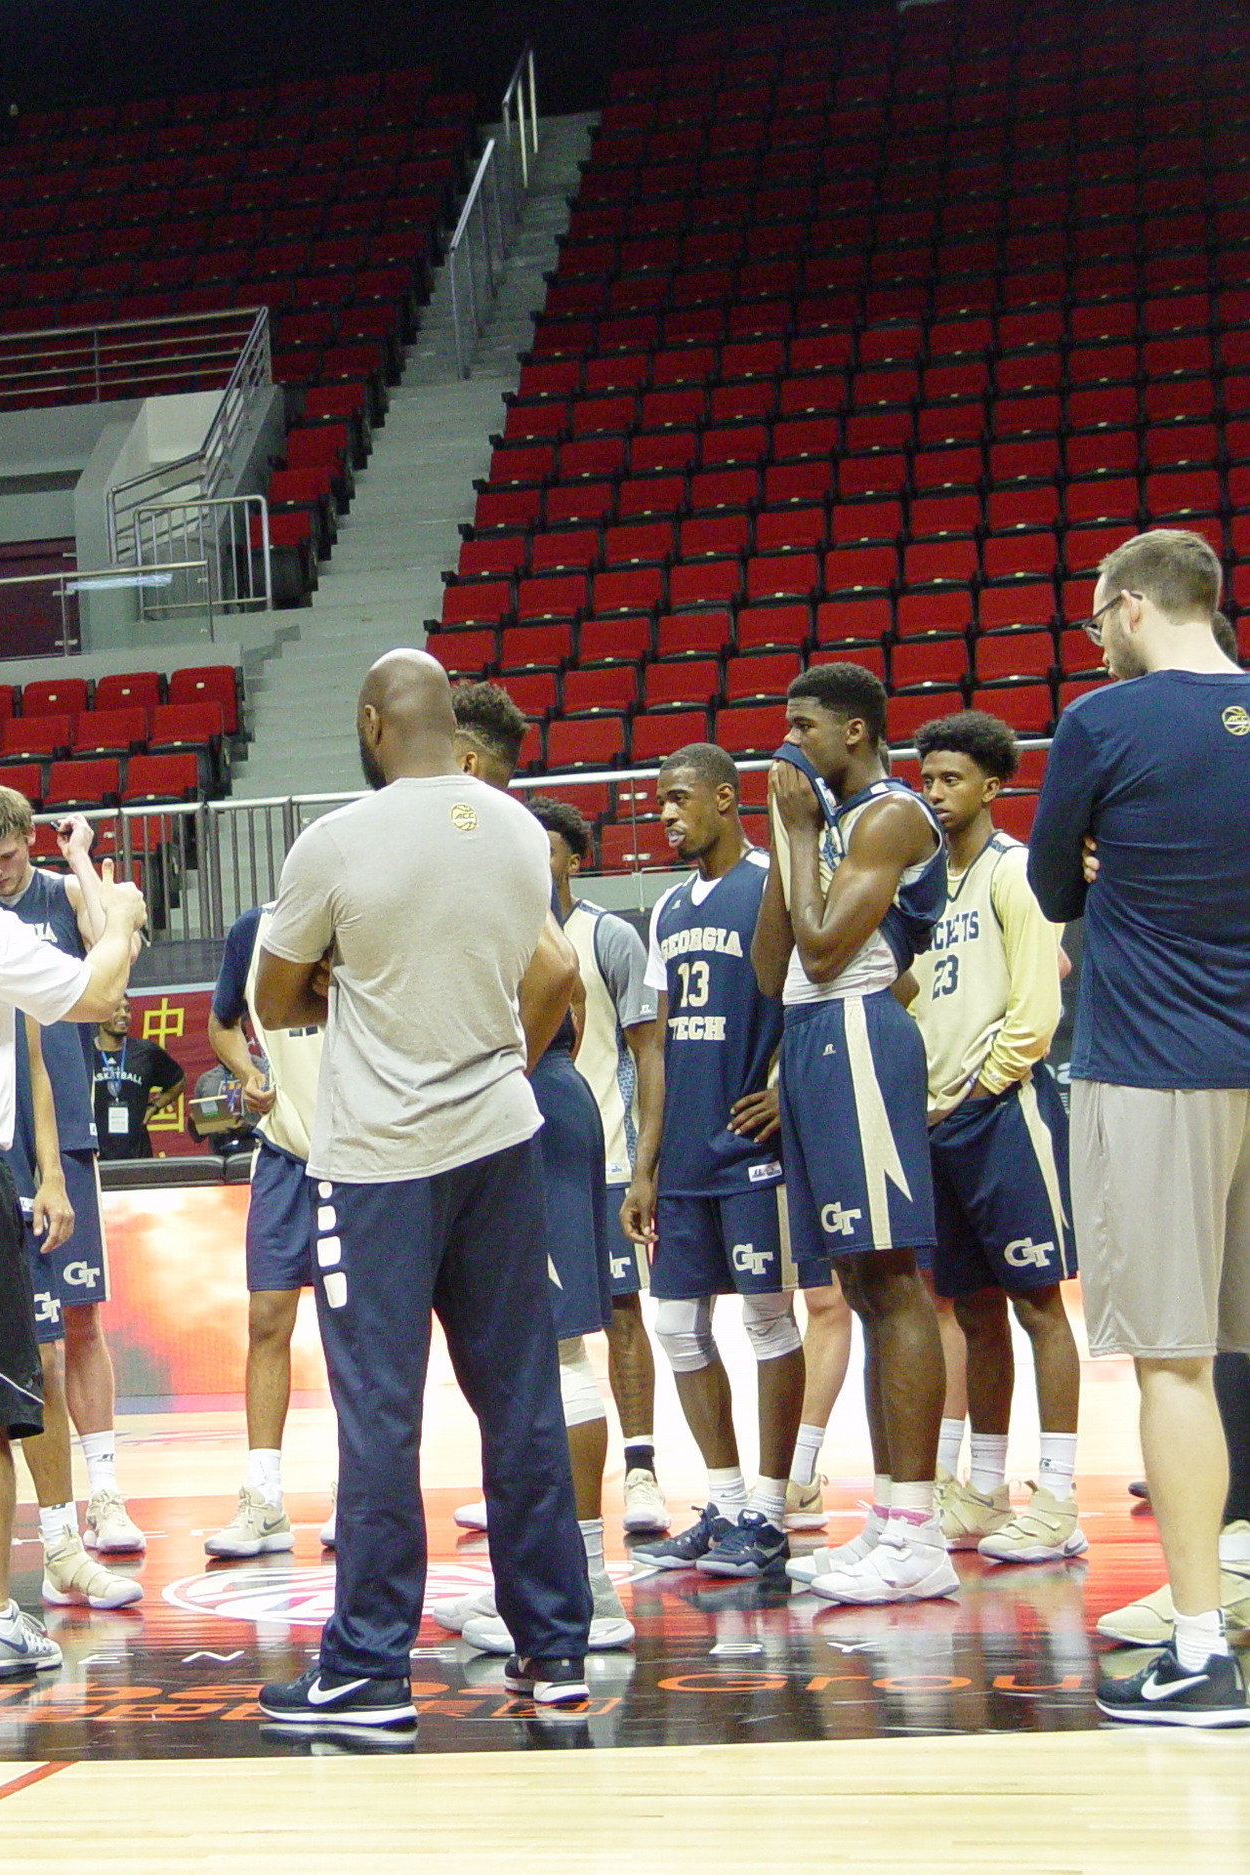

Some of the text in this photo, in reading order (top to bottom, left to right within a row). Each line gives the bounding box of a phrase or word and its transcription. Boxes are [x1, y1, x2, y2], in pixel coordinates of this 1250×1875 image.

[928, 910, 980, 951] CKETS
[677, 960, 710, 1008] 13
[931, 954, 960, 1002] 23
[667, 1015, 726, 1041] TECH
[821, 1201, 861, 1236] GT
[609, 1252, 631, 1278] T
[733, 1243, 773, 1275] GT
[1004, 1237, 1055, 1268] GT
[63, 1261, 101, 1288] GT
[657, 1672, 1083, 1693] Grou
